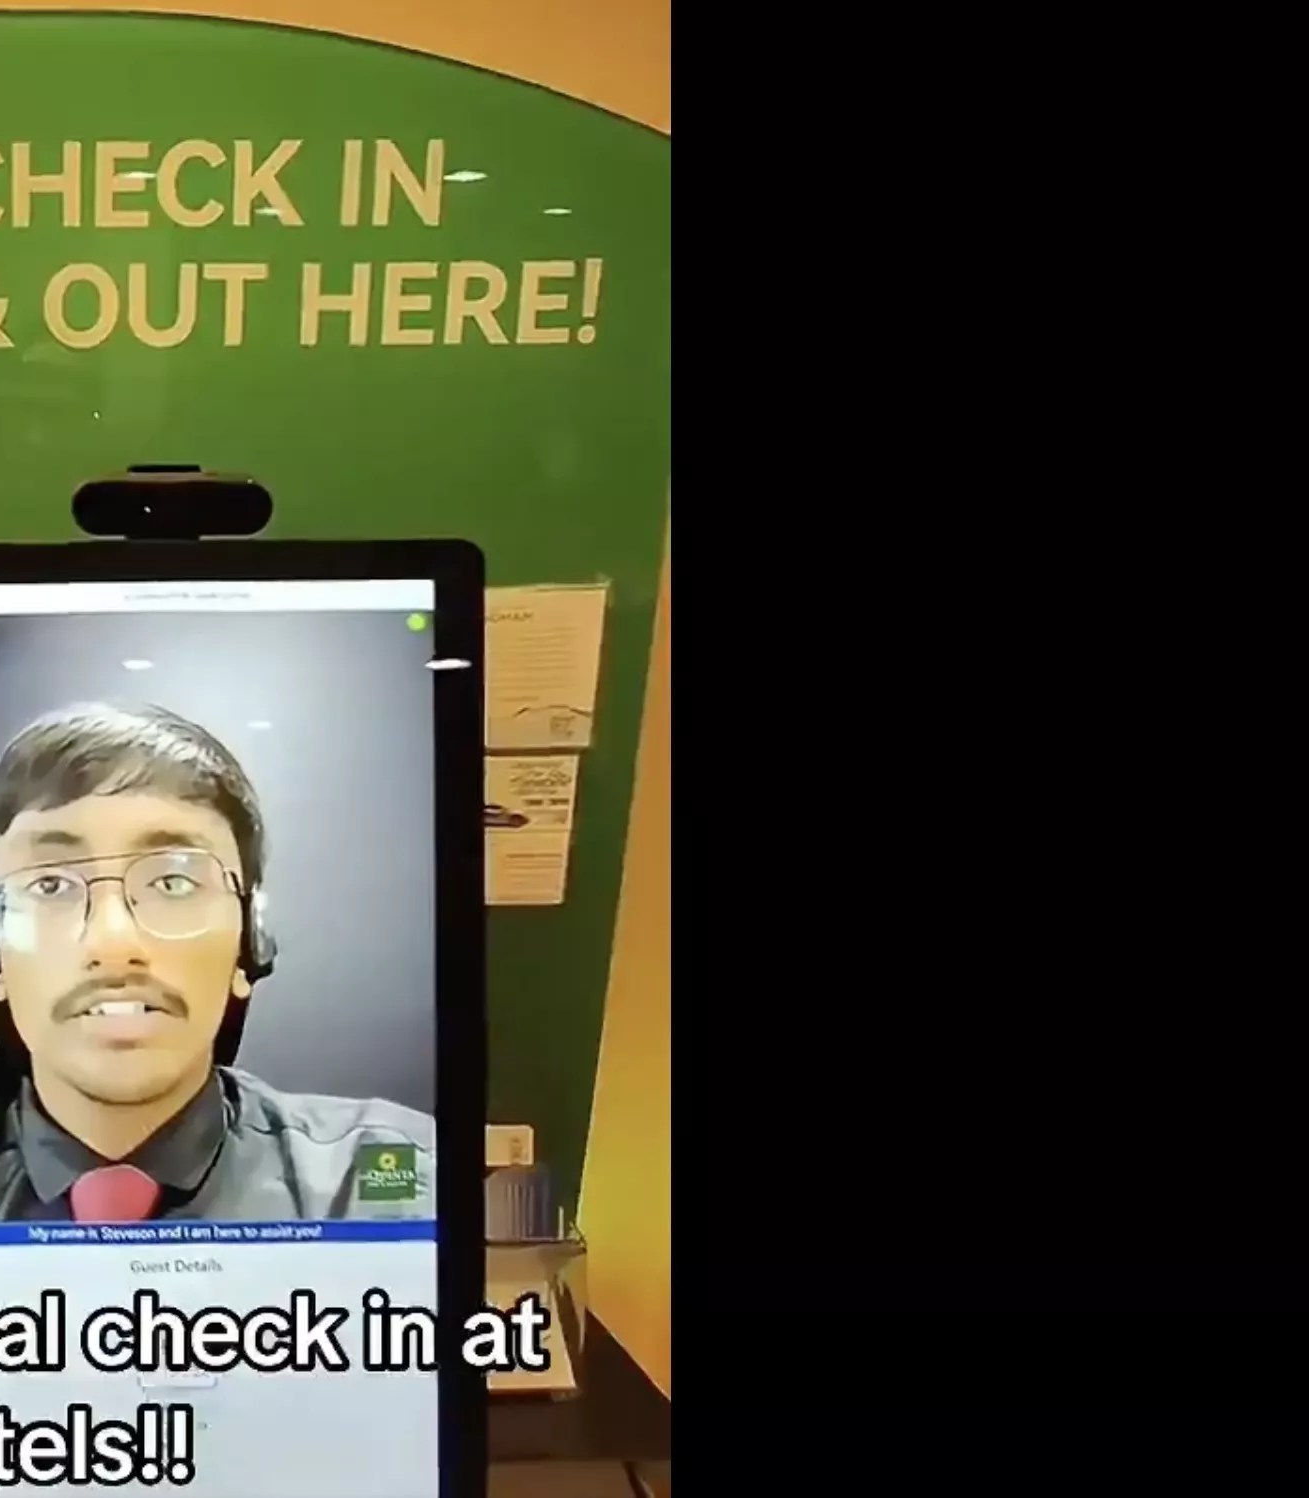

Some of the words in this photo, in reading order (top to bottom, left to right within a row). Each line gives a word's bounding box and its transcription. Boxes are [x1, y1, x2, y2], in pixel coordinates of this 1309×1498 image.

[340, 138, 445, 226] IN
[43, 262, 269, 348] OUT
[299, 257, 603, 346] HERE!
[28, 1225, 48, 1242] My
[52, 1228, 84, 1239] name
[88, 1226, 98, 1239] is
[159, 1226, 181, 1239] and
[192, 1227, 211, 1240] am
[213, 1225, 241, 1239] here
[243, 1226, 258, 1239] to
[260, 1225, 293, 1239] assist
[130, 1259, 170, 1274] Guest
[175, 1258, 223, 1273] Details
